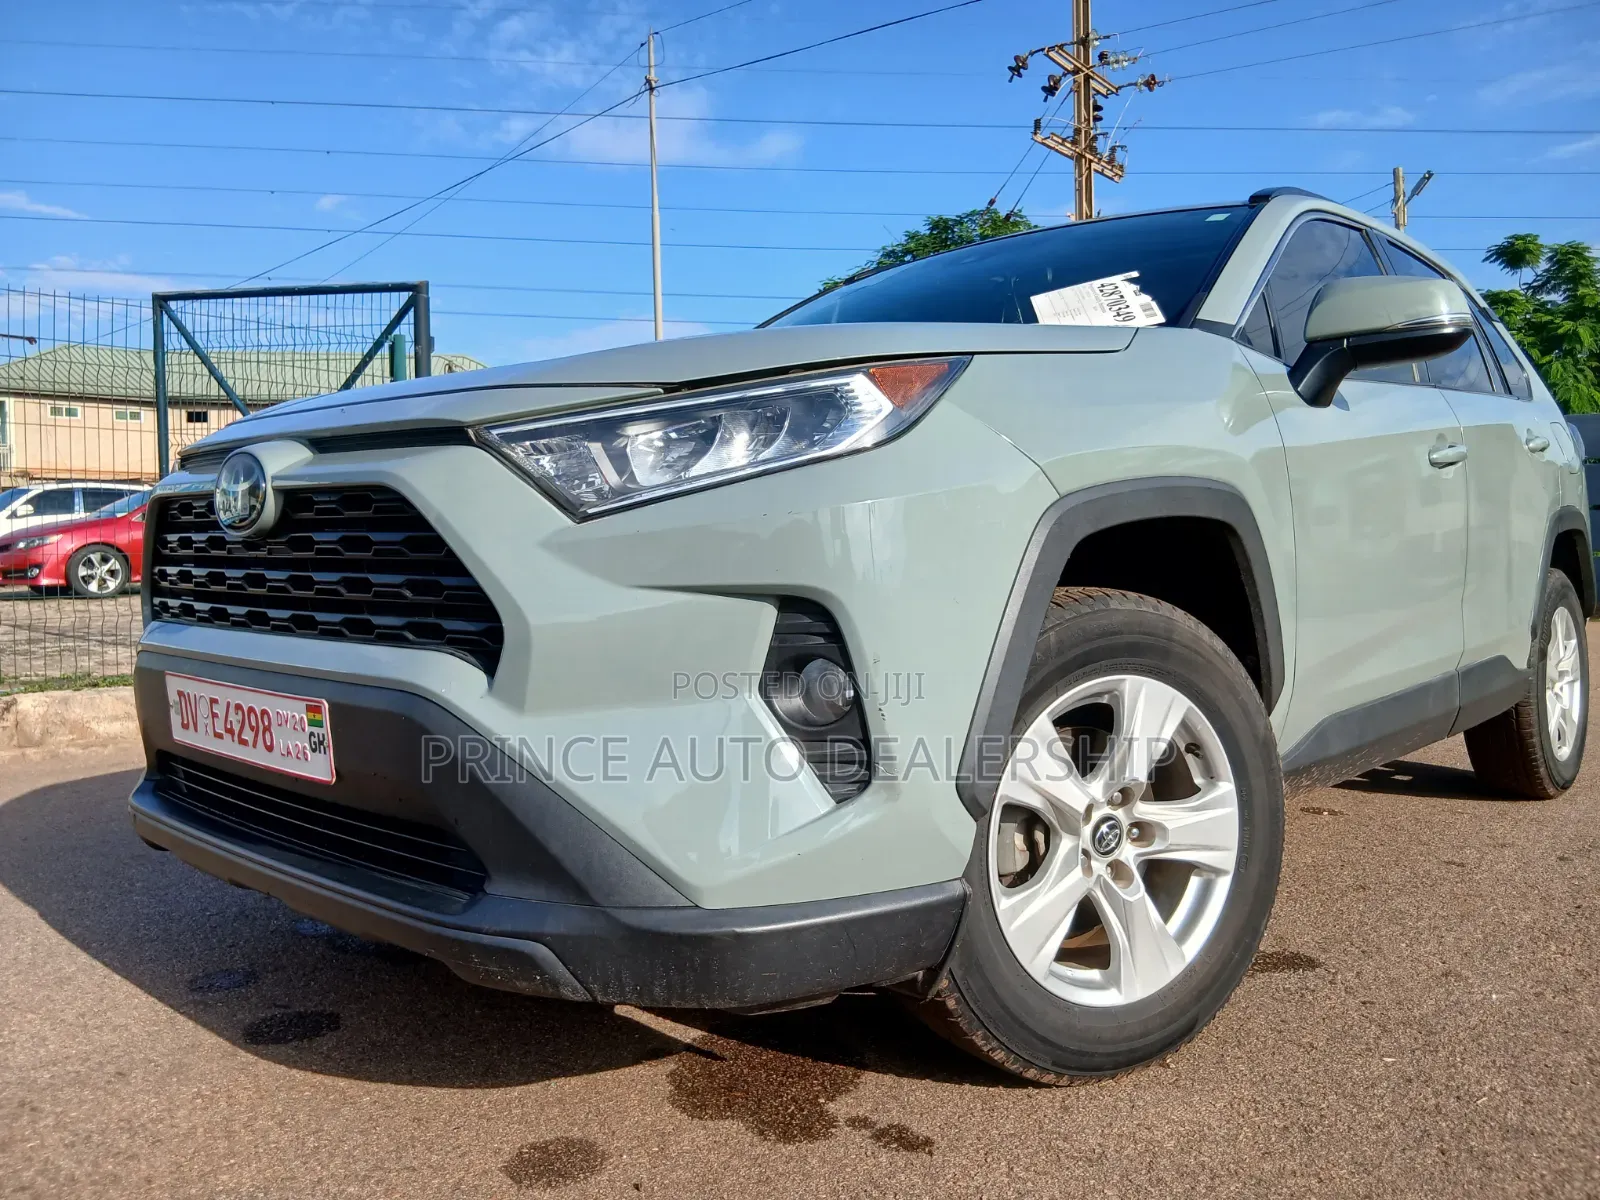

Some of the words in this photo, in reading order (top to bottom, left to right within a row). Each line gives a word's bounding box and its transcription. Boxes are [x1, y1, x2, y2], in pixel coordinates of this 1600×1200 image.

[1097, 282, 1136, 323] 42870349
[177, 689, 199, 733] DV
[209, 697, 275, 752] E4298
[308, 731, 327, 755] GH
